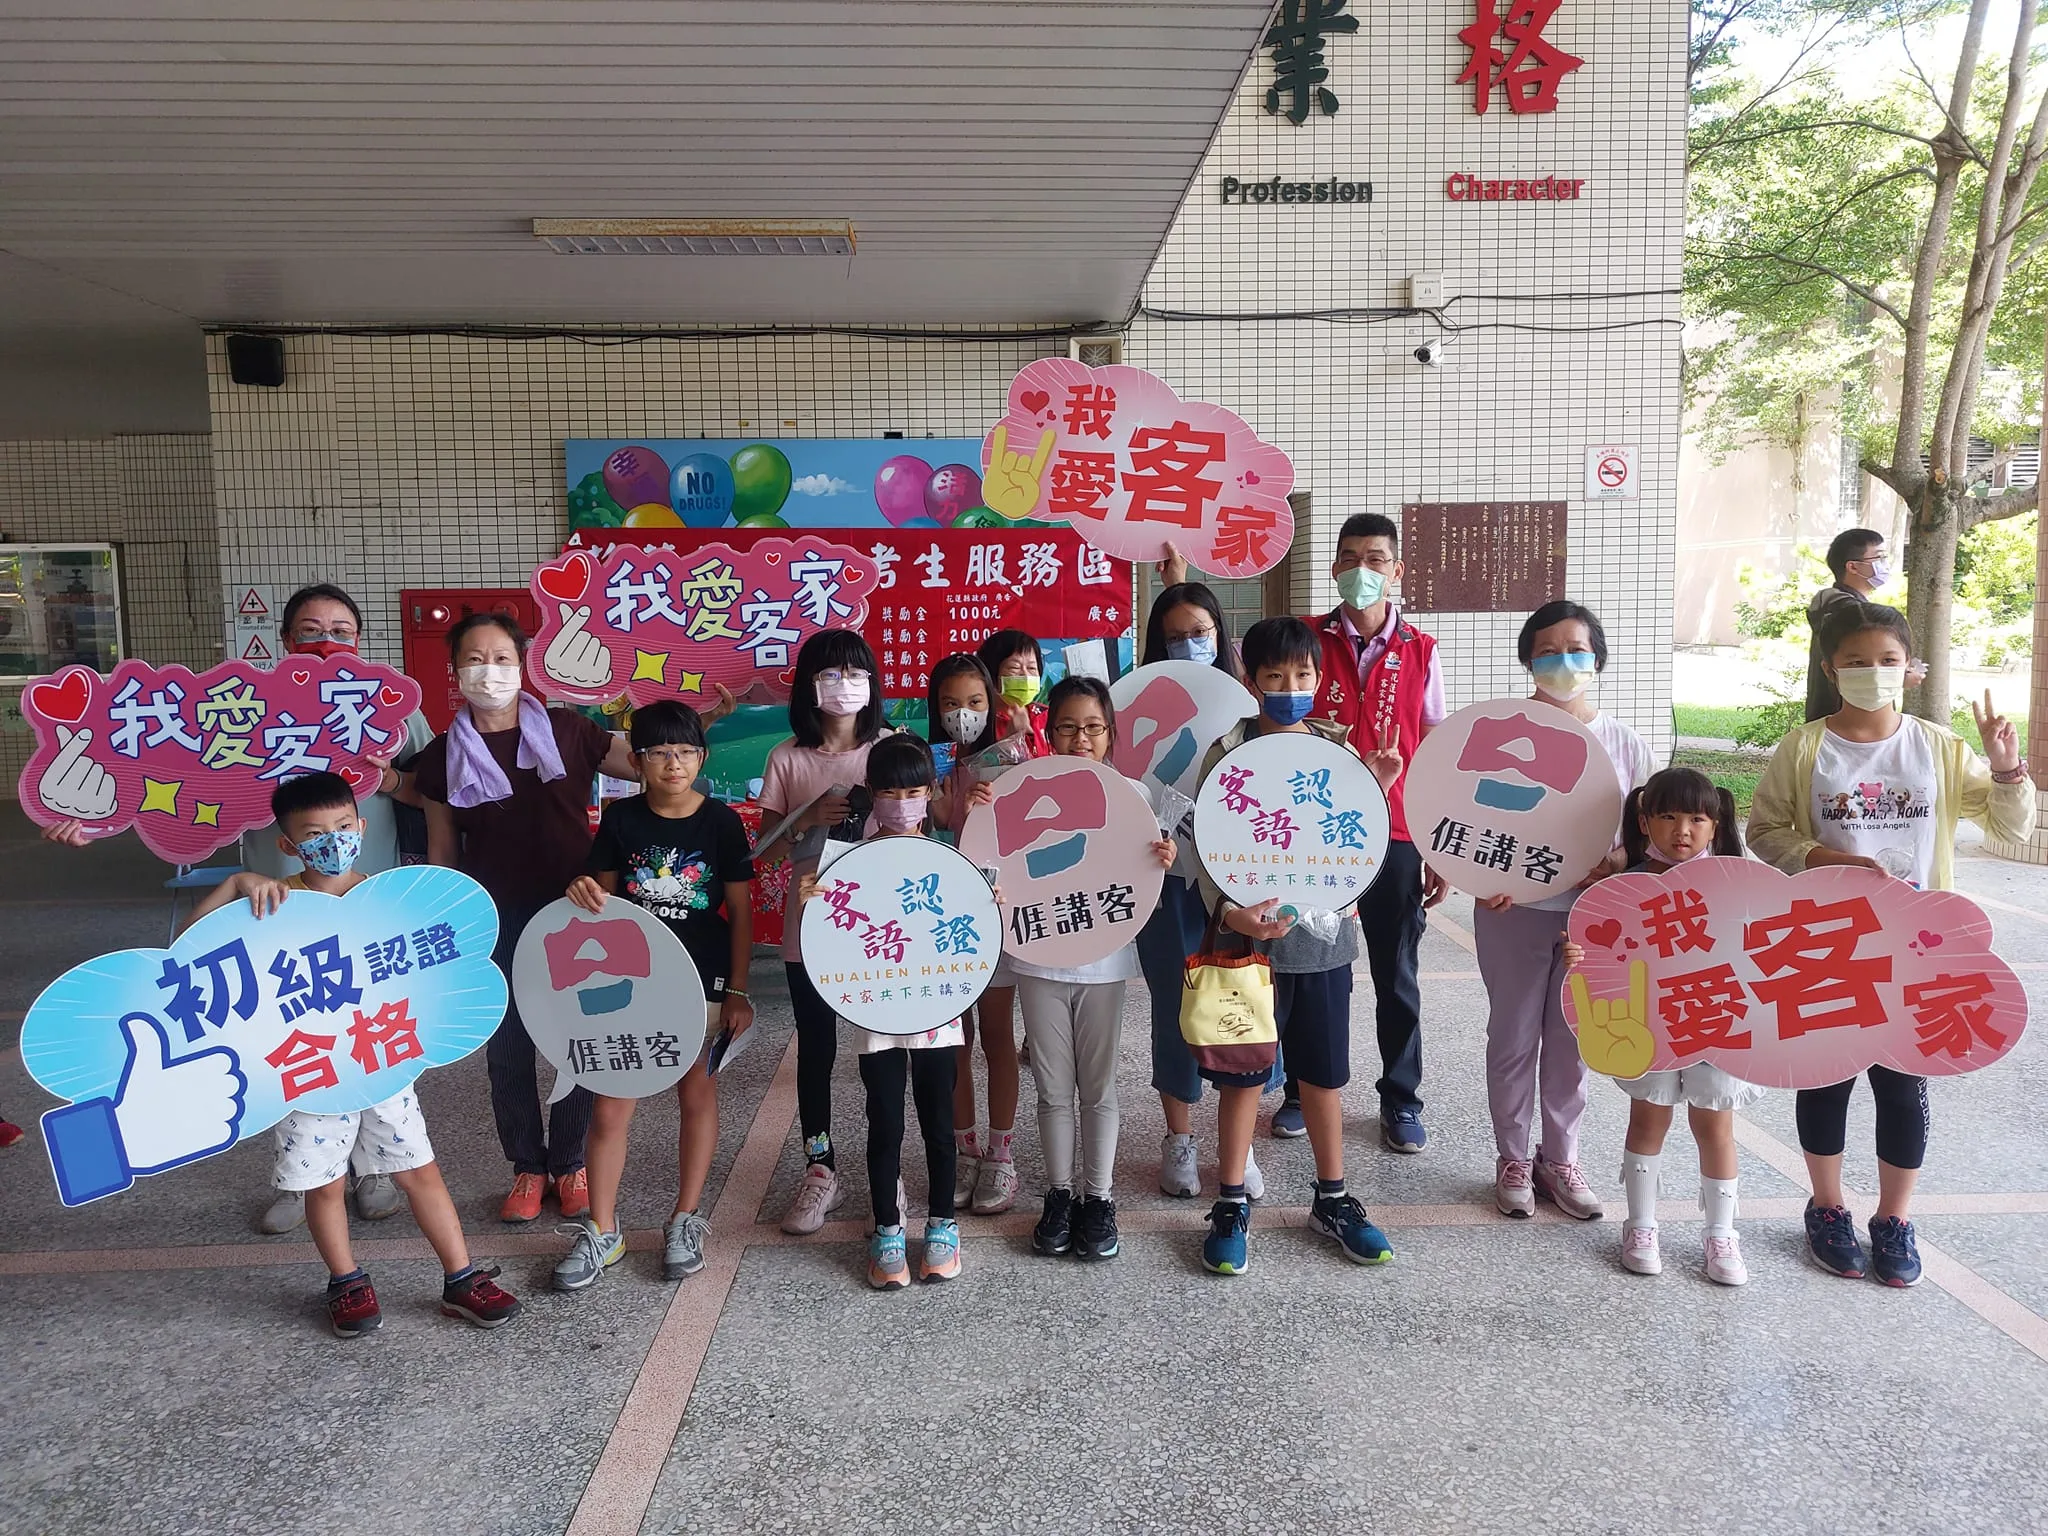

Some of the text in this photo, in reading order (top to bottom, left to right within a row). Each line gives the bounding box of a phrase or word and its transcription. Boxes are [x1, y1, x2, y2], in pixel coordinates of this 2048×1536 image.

[1260, 0, 1360, 127] 業
[1455, 0, 1586, 117] 格
[1222, 175, 1374, 205] Profession
[1447, 172, 1586, 201] Character
[686, 472, 715, 495] NO
[679, 498, 726, 511] DRUGS!
[949, 604, 1001, 620] 1000元
[1087, 605, 1120, 622] 廣告
[1896, 805, 1930, 819] HOME
[1840, 822, 1911, 831] WITH Losa Angels
[1208, 852, 1376, 866] HUALIEN HAKKA
[1226, 872, 1358, 889] 大家共下來講客
[820, 960, 990, 985] HUALIEN HAKKA
[840, 981, 973, 1005] 大家共下來講客
[264, 997, 425, 1103] 合格
